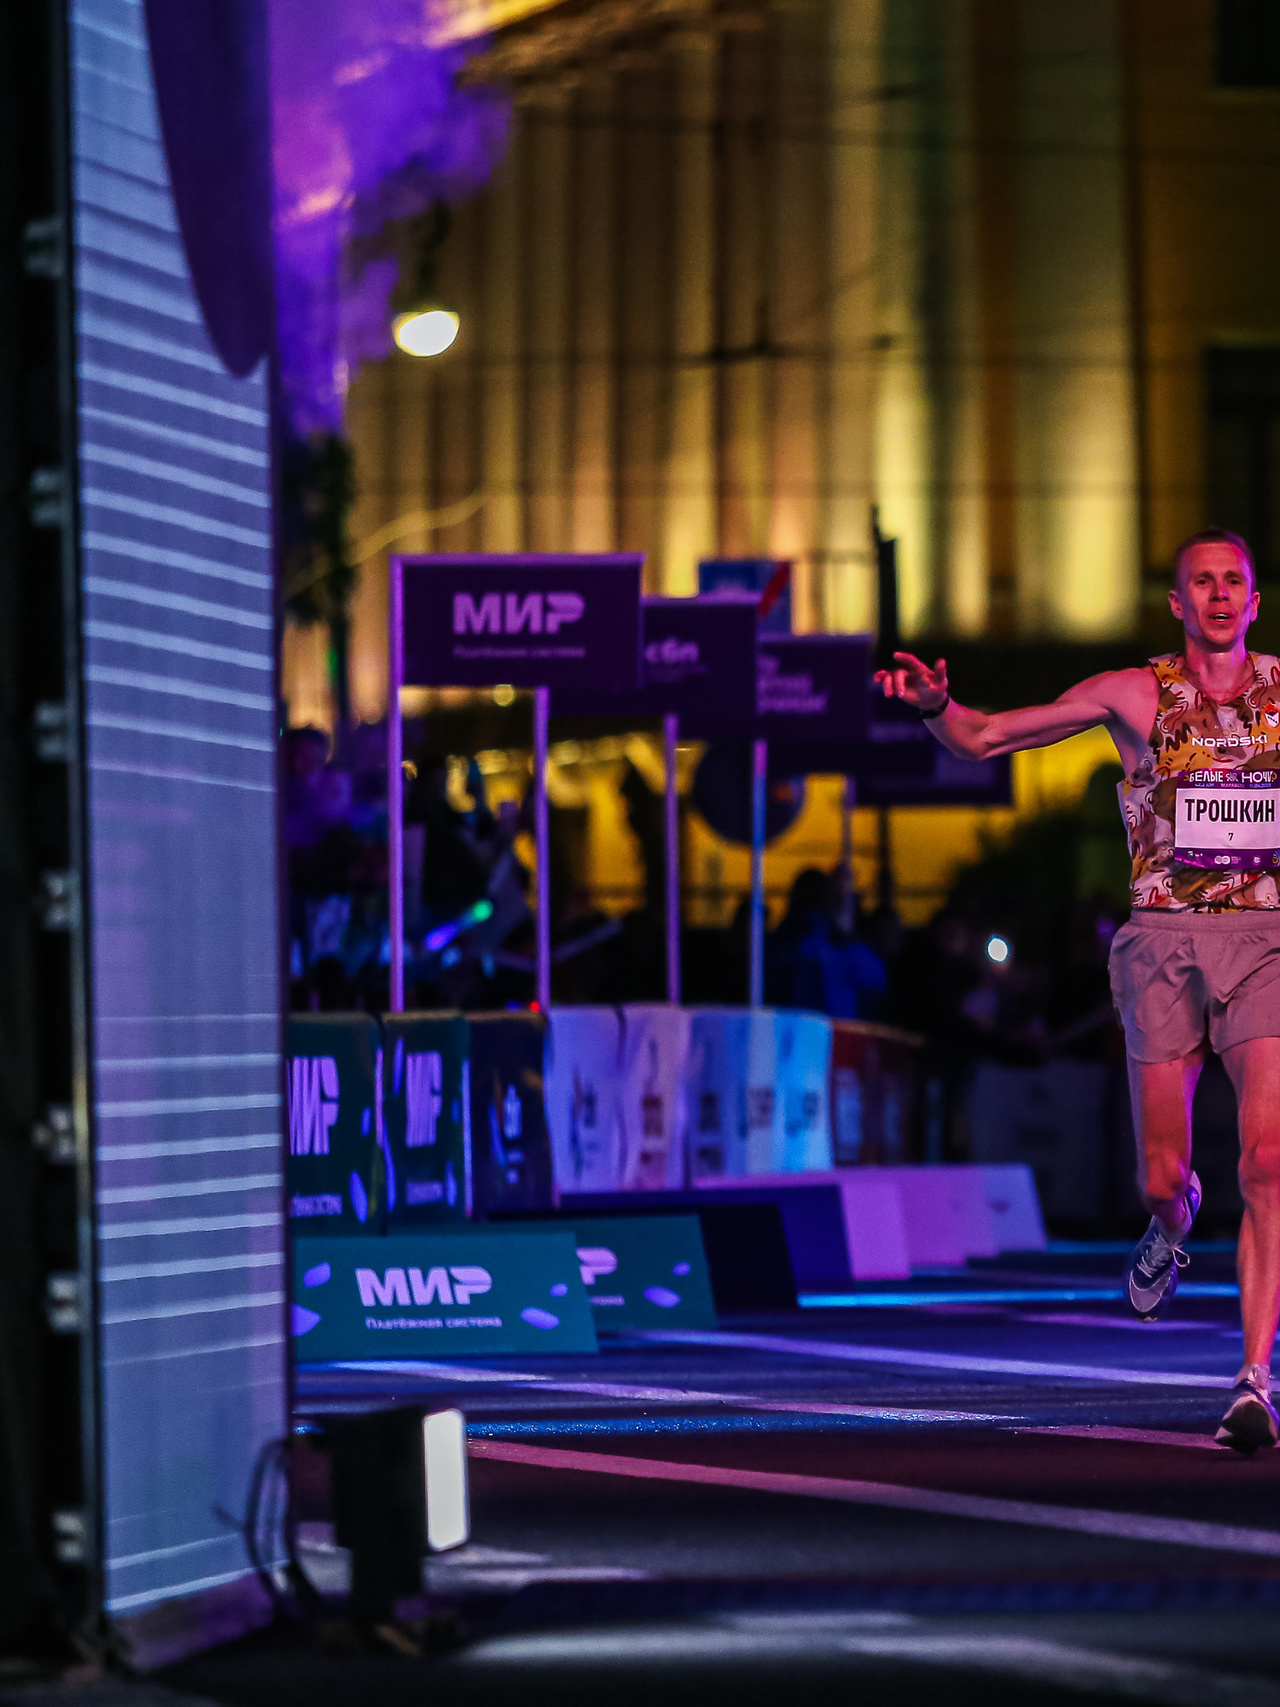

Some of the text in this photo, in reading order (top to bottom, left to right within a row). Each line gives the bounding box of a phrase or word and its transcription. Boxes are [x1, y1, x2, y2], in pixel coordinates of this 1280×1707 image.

[453, 592, 585, 635] МИР
[1191, 734, 1268, 748] NORDSKI
[1189, 770, 1224, 783] БЕЛЫЕ
[1184, 798, 1275, 823] ТРОШКИН
[1228, 832, 1234, 841] 7
[355, 1265, 493, 1307] МИР
